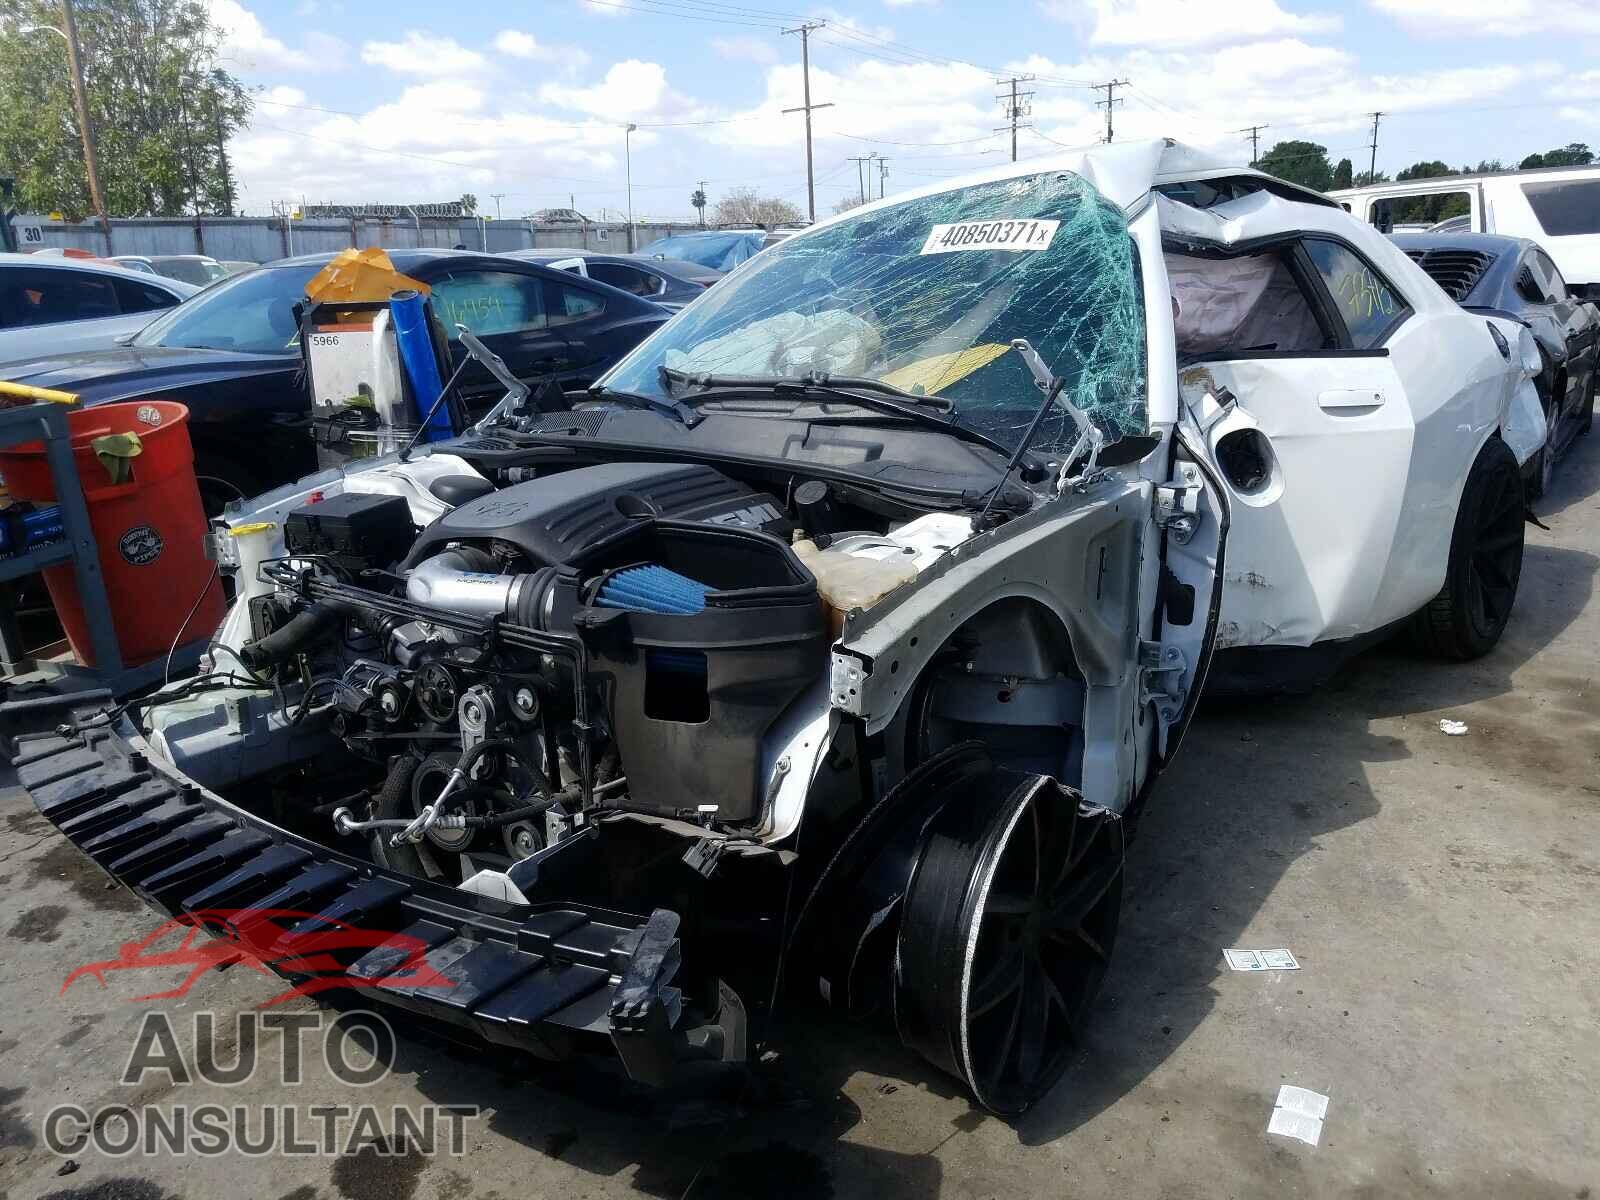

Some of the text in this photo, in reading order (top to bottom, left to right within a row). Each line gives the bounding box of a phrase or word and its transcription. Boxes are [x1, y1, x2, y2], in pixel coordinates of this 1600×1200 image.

[24, 227, 41, 241] 30
[941, 222, 1039, 247] 40850371
[313, 335, 340, 346] 5966
